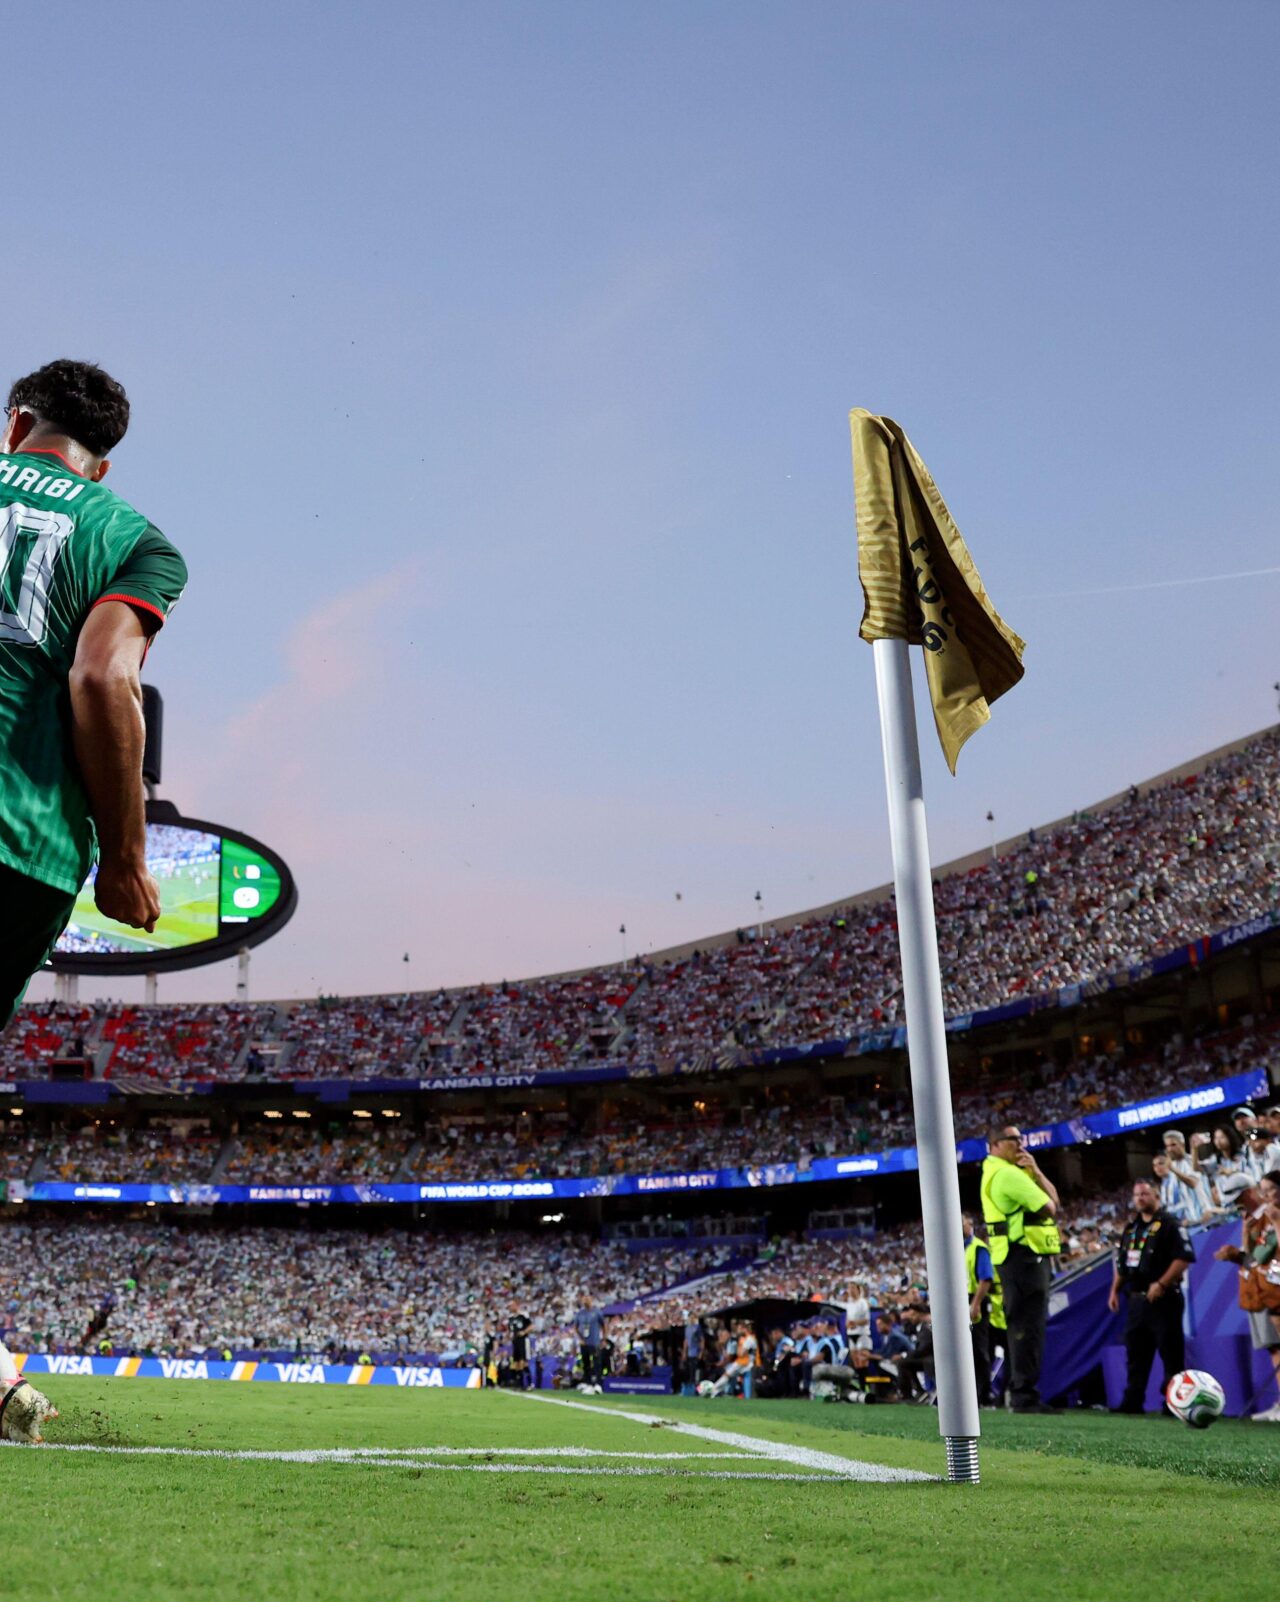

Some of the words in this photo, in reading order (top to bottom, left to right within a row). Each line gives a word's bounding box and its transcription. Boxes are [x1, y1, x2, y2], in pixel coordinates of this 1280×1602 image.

[420, 1076, 493, 1090] KANSAS
[495, 1075, 536, 1087] CITY
[638, 1176, 688, 1190] KANSAS
[688, 1174, 718, 1188] CITY
[249, 1188, 301, 1200] KANSAS
[420, 1186, 446, 1199] FIFA
[446, 1185, 488, 1198] WORLD
[488, 1184, 513, 1197] CUP
[43, 1354, 94, 1375] VISA
[158, 1358, 209, 1379] VISA
[274, 1362, 326, 1383] VISA
[392, 1366, 444, 1387] VISA
